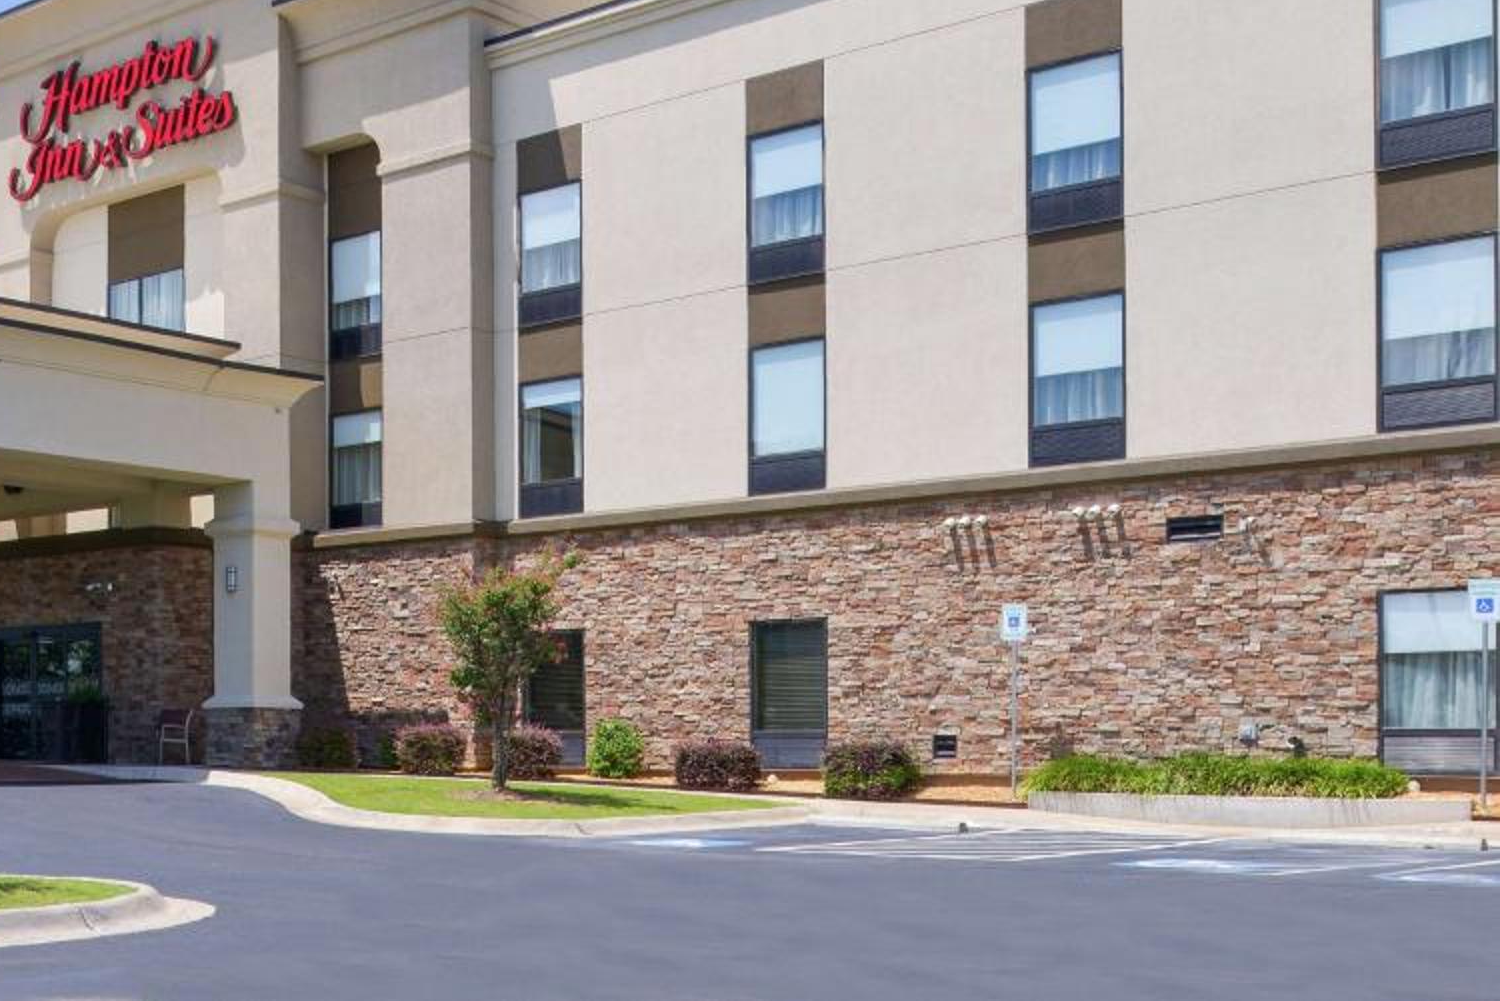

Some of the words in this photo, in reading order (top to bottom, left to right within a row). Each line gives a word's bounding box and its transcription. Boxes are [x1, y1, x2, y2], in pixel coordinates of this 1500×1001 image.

[9, 137, 100, 202] Inn
[99, 129, 126, 168] &
[122, 88, 236, 160] Suites
[19, 35, 215, 144] Hampton
